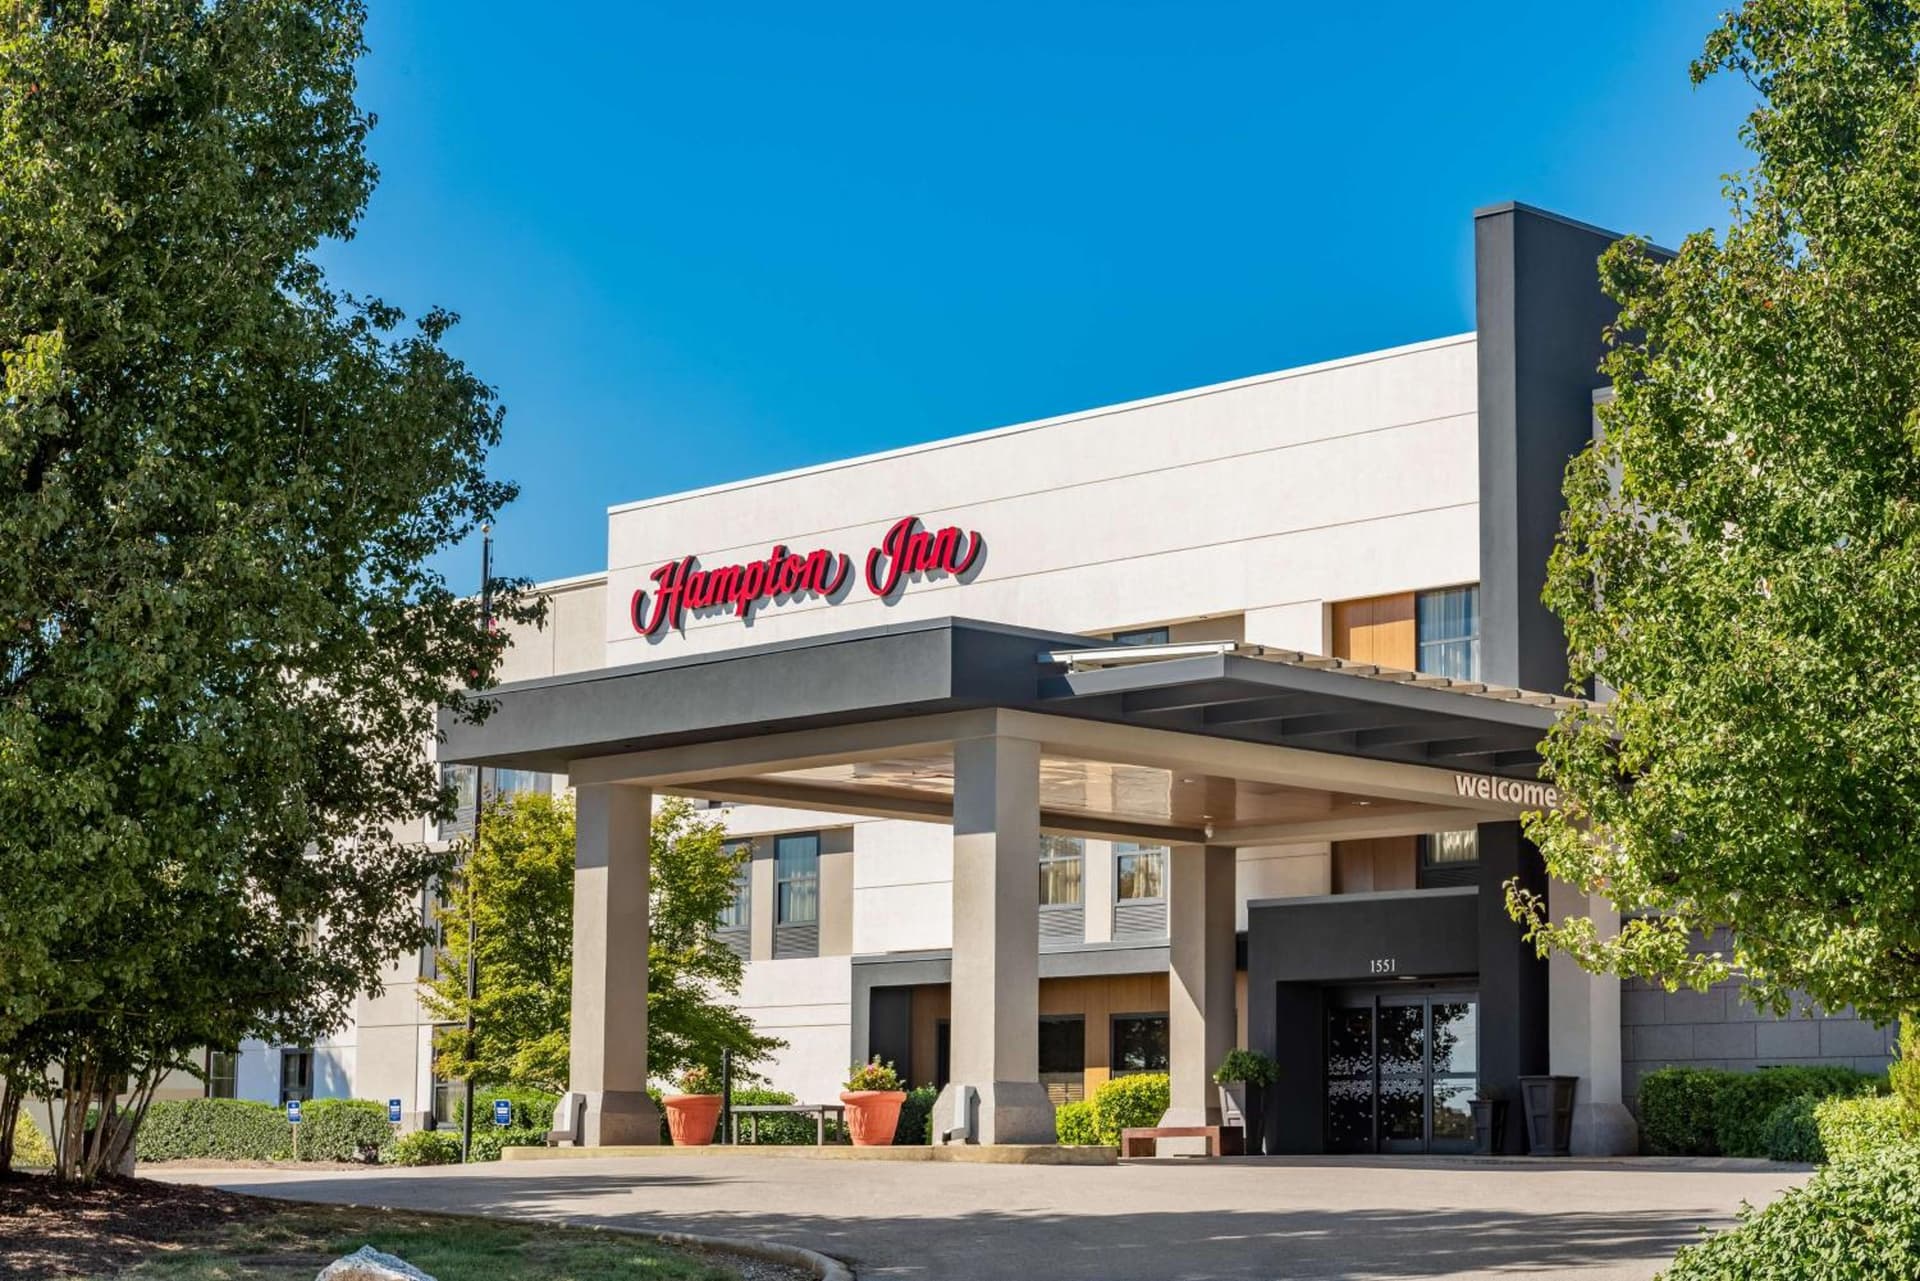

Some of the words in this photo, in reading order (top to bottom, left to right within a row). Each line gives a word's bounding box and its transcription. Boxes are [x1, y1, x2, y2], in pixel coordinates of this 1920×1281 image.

[631, 545, 852, 635] Hampton
[866, 515, 984, 597] Inn
[1455, 774, 1558, 808] welcome
[1371, 958, 1396, 973] 1551
